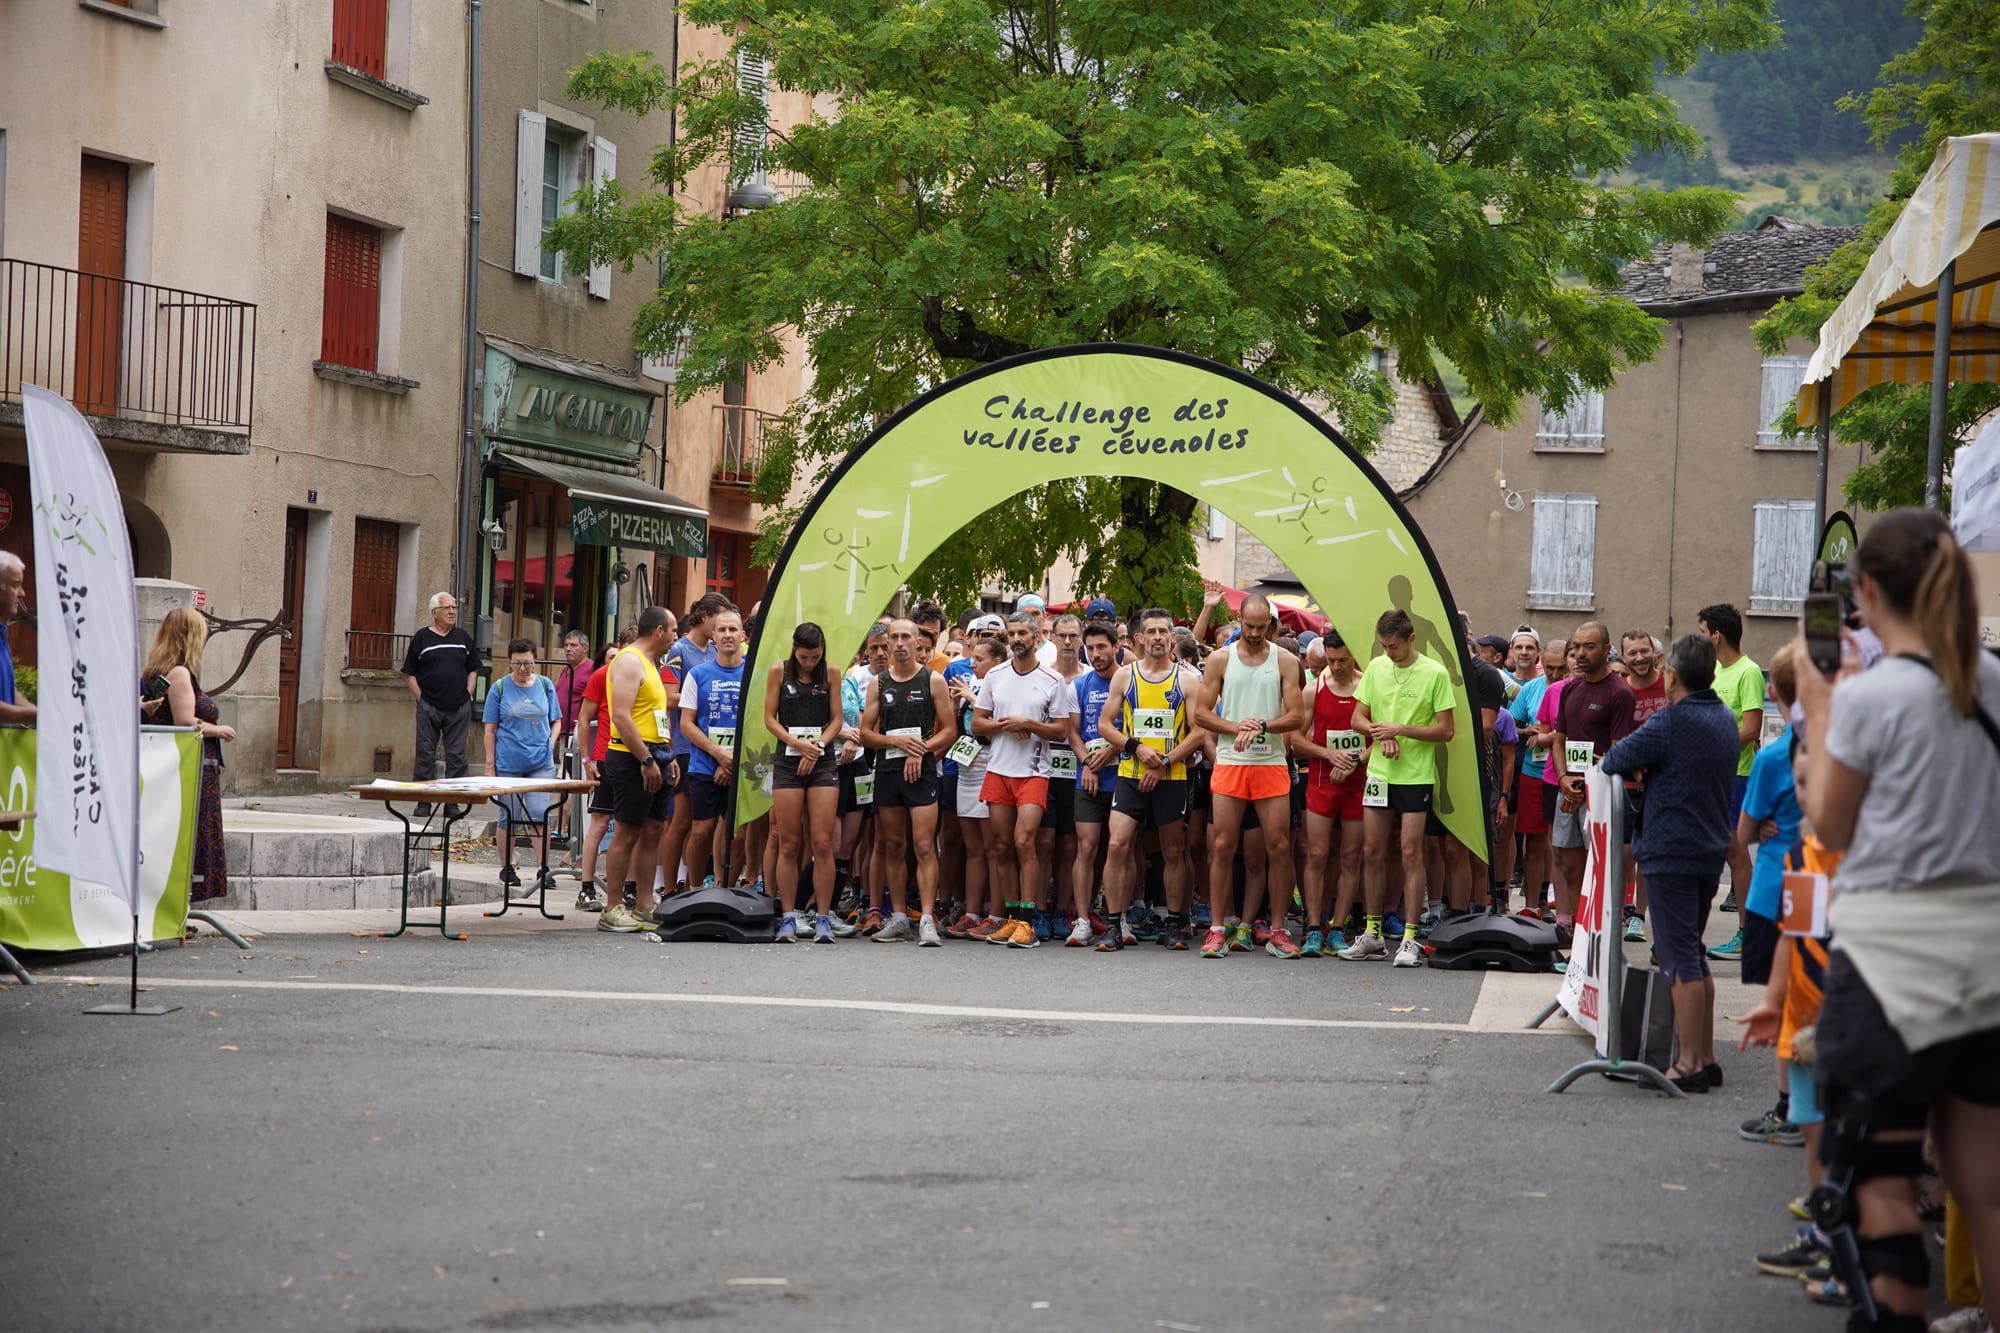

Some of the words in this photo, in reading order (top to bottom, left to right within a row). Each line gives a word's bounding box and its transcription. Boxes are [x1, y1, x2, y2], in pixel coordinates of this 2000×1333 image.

[520, 387, 559, 421] AU
[984, 395, 1151, 433] Challenge
[1173, 398, 1229, 422] des
[963, 427, 1081, 454] vallées
[1102, 428, 1249, 455] cévenoles
[572, 505, 594, 527] PIZZA
[610, 512, 674, 547] PIZZERIA
[1144, 716, 1164, 729] 48
[716, 734, 734, 746] 77
[1332, 736, 1360, 749] 100
[1567, 749, 1588, 762] 104
[1051, 756, 1070, 769] 82
[1366, 784, 1379, 797] 43
